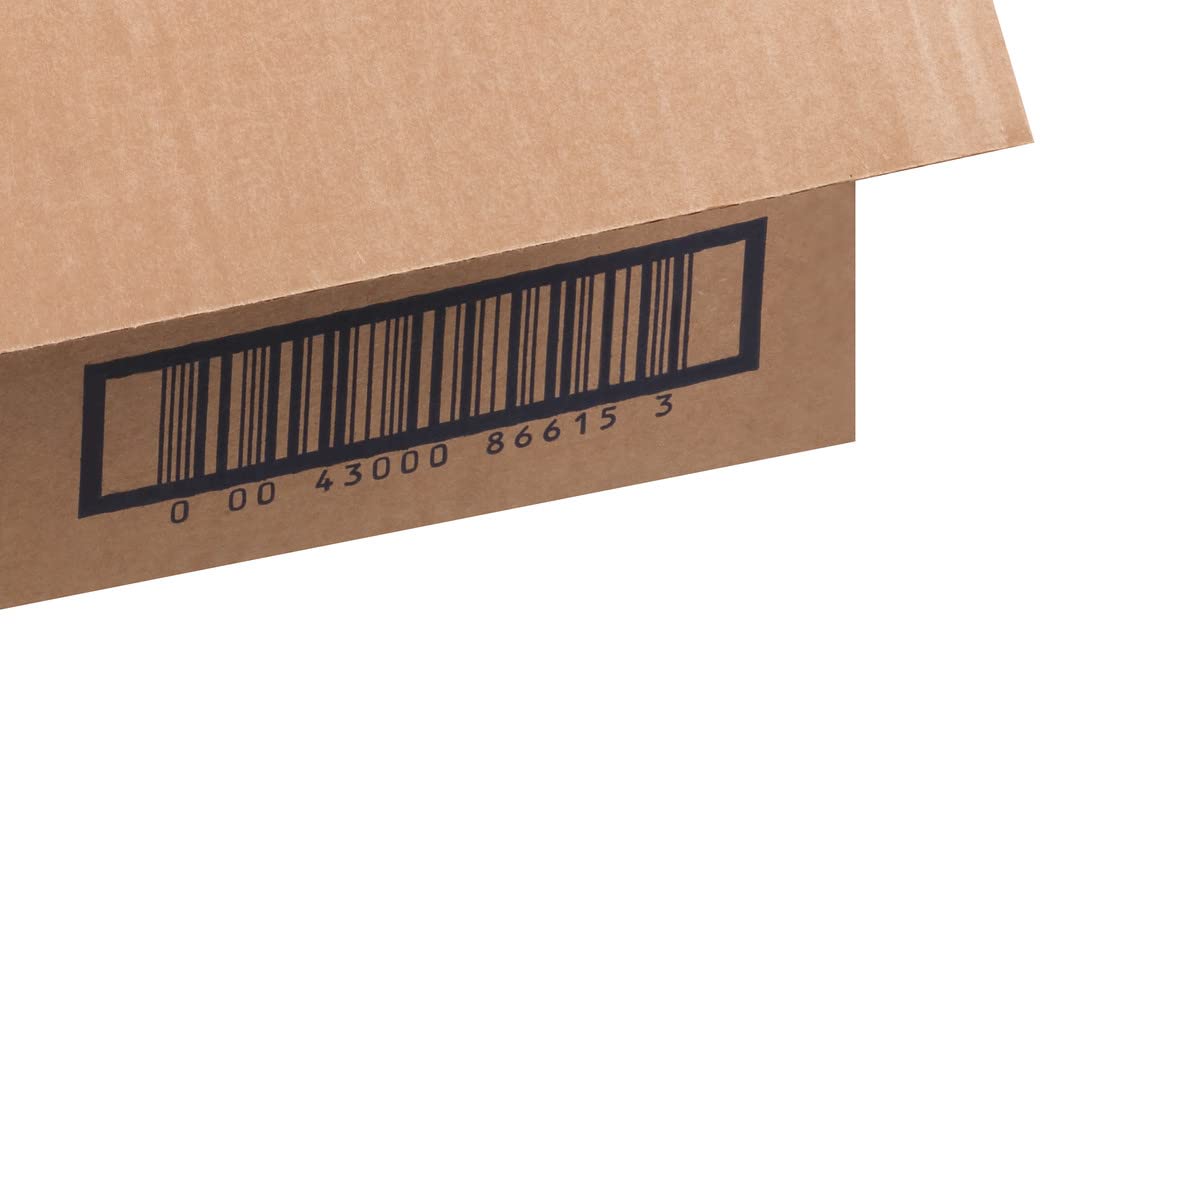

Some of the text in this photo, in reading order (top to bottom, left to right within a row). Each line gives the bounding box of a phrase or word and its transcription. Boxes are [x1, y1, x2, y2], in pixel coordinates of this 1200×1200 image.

[170, 394, 672, 524] 0 00 43000 86615 3
